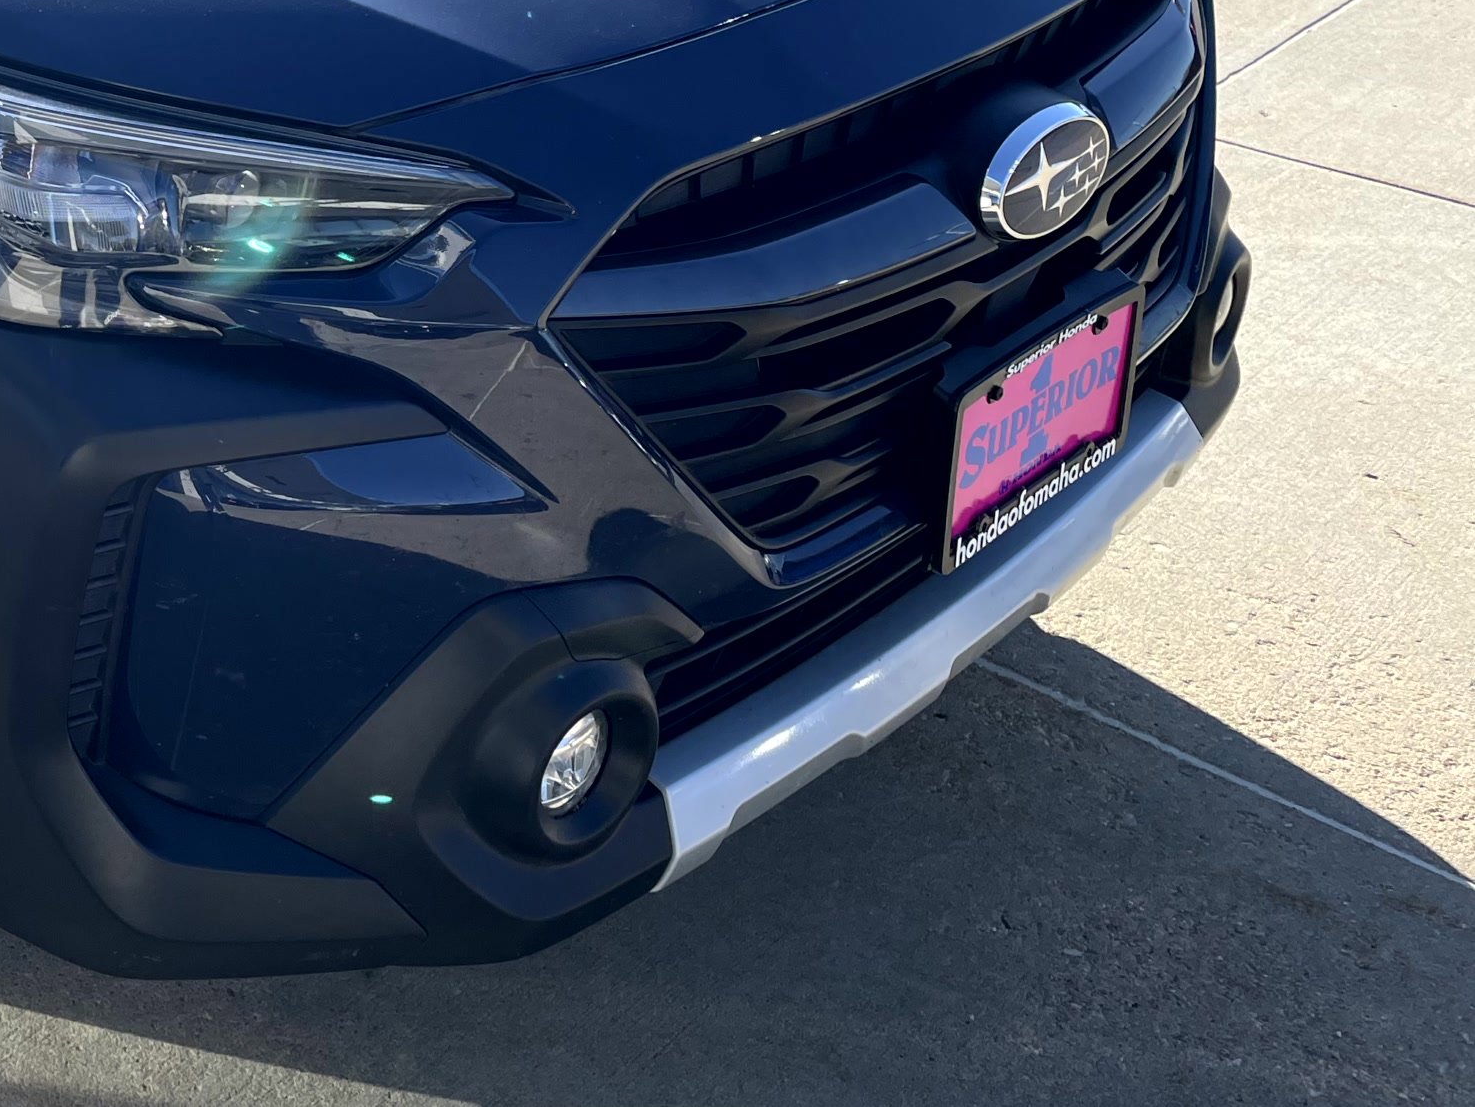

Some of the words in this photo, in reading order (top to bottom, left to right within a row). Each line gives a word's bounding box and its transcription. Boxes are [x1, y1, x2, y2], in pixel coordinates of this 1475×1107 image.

[1006, 339, 1056, 379] Superior
[1058, 313, 1098, 345] Honda
[955, 438, 1117, 568] hondaofomaha.com
